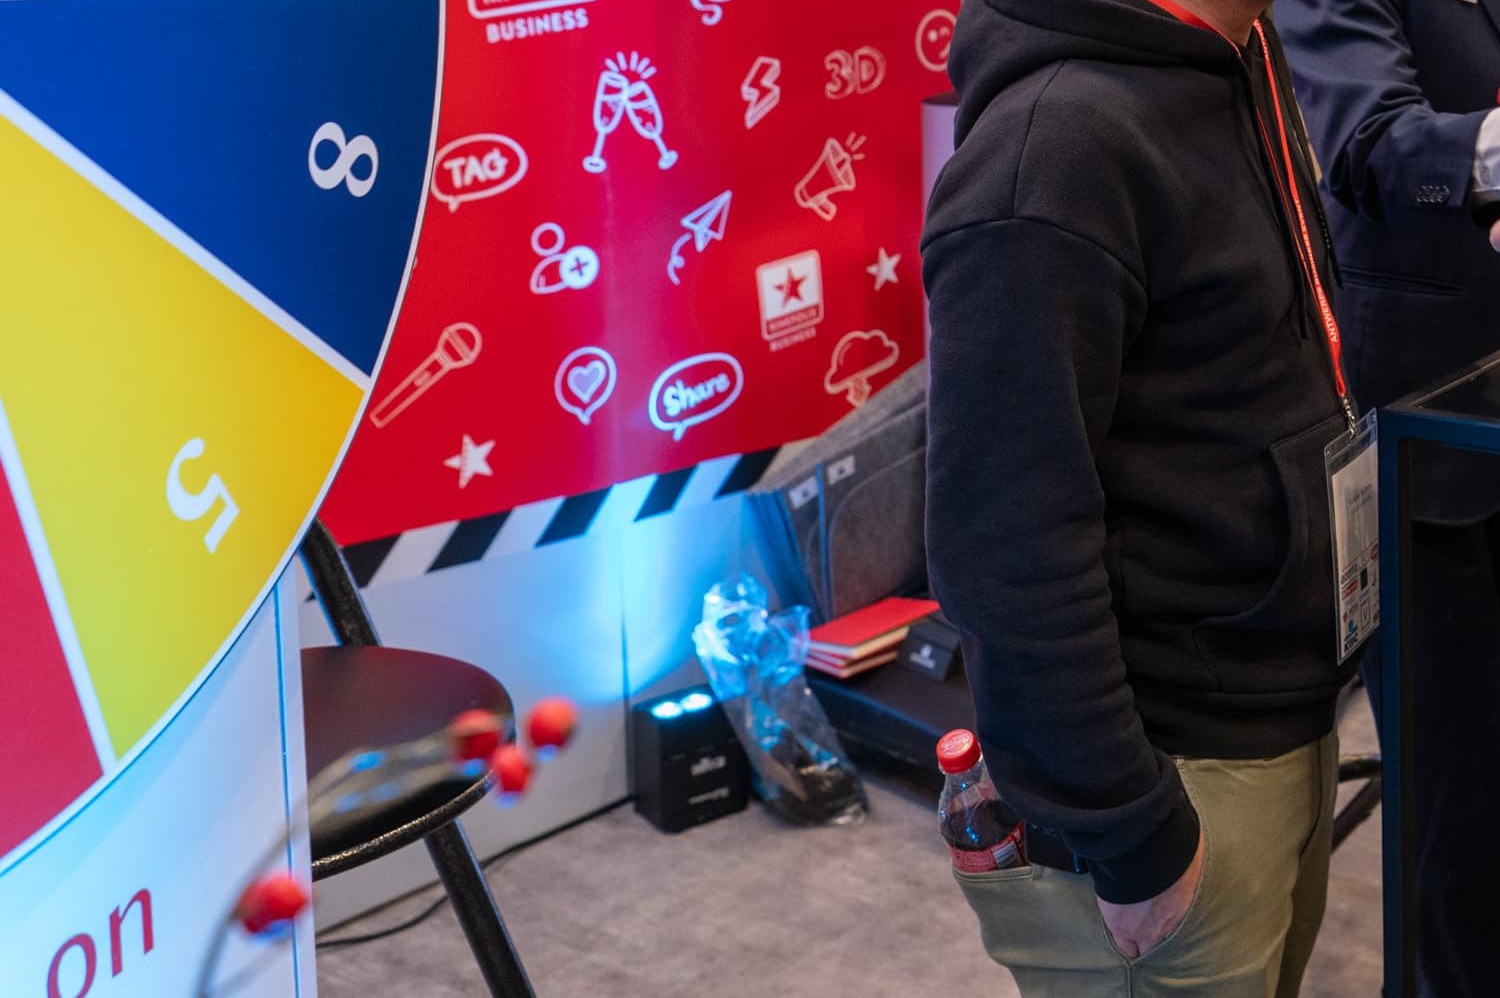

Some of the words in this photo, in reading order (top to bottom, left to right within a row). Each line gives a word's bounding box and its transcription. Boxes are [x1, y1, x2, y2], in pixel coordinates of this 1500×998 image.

[486, 8, 590, 44] BUSINESS
[824, 45, 887, 100] 3D
[308, 121, 379, 198] 8
[443, 147, 509, 190] TAG
[663, 373, 731, 417] Share
[166, 436, 240, 554] 5
